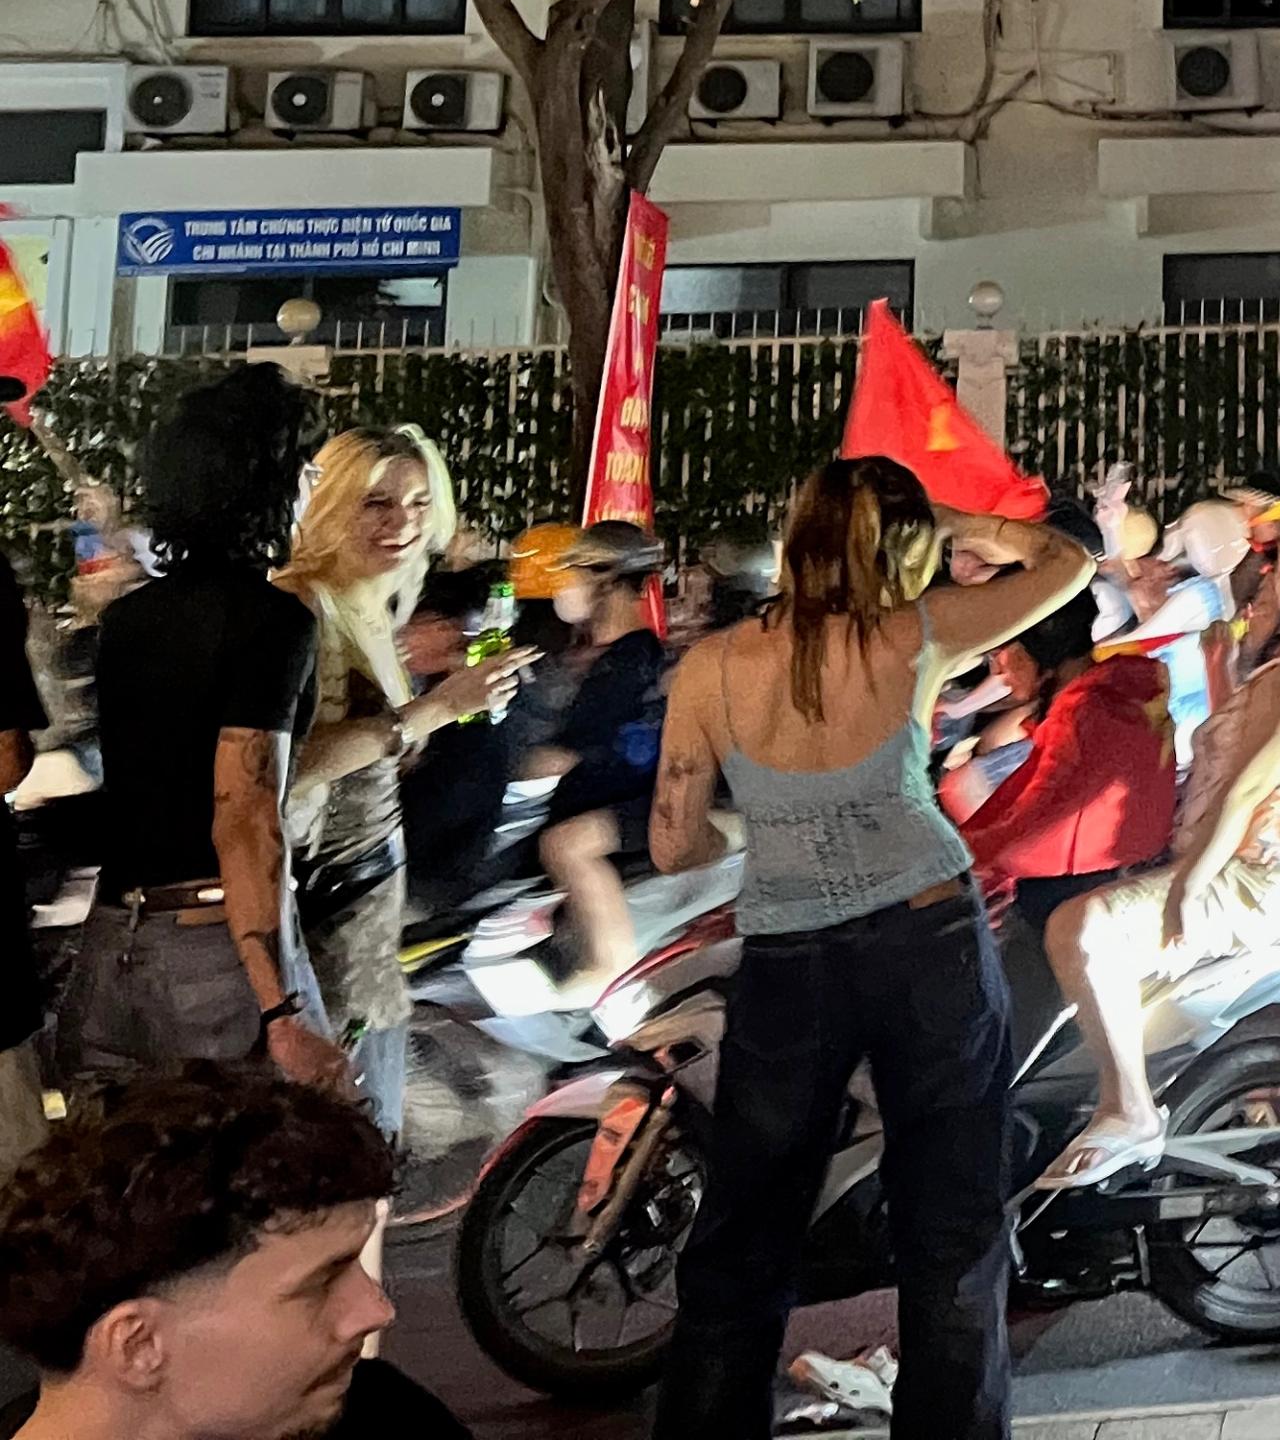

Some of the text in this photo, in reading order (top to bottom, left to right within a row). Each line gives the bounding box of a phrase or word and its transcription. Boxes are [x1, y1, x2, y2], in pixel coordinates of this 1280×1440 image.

[230, 217, 257, 235] TÂM
[193, 244, 215, 260] CHI
[382, 238, 404, 256] CHÍ
